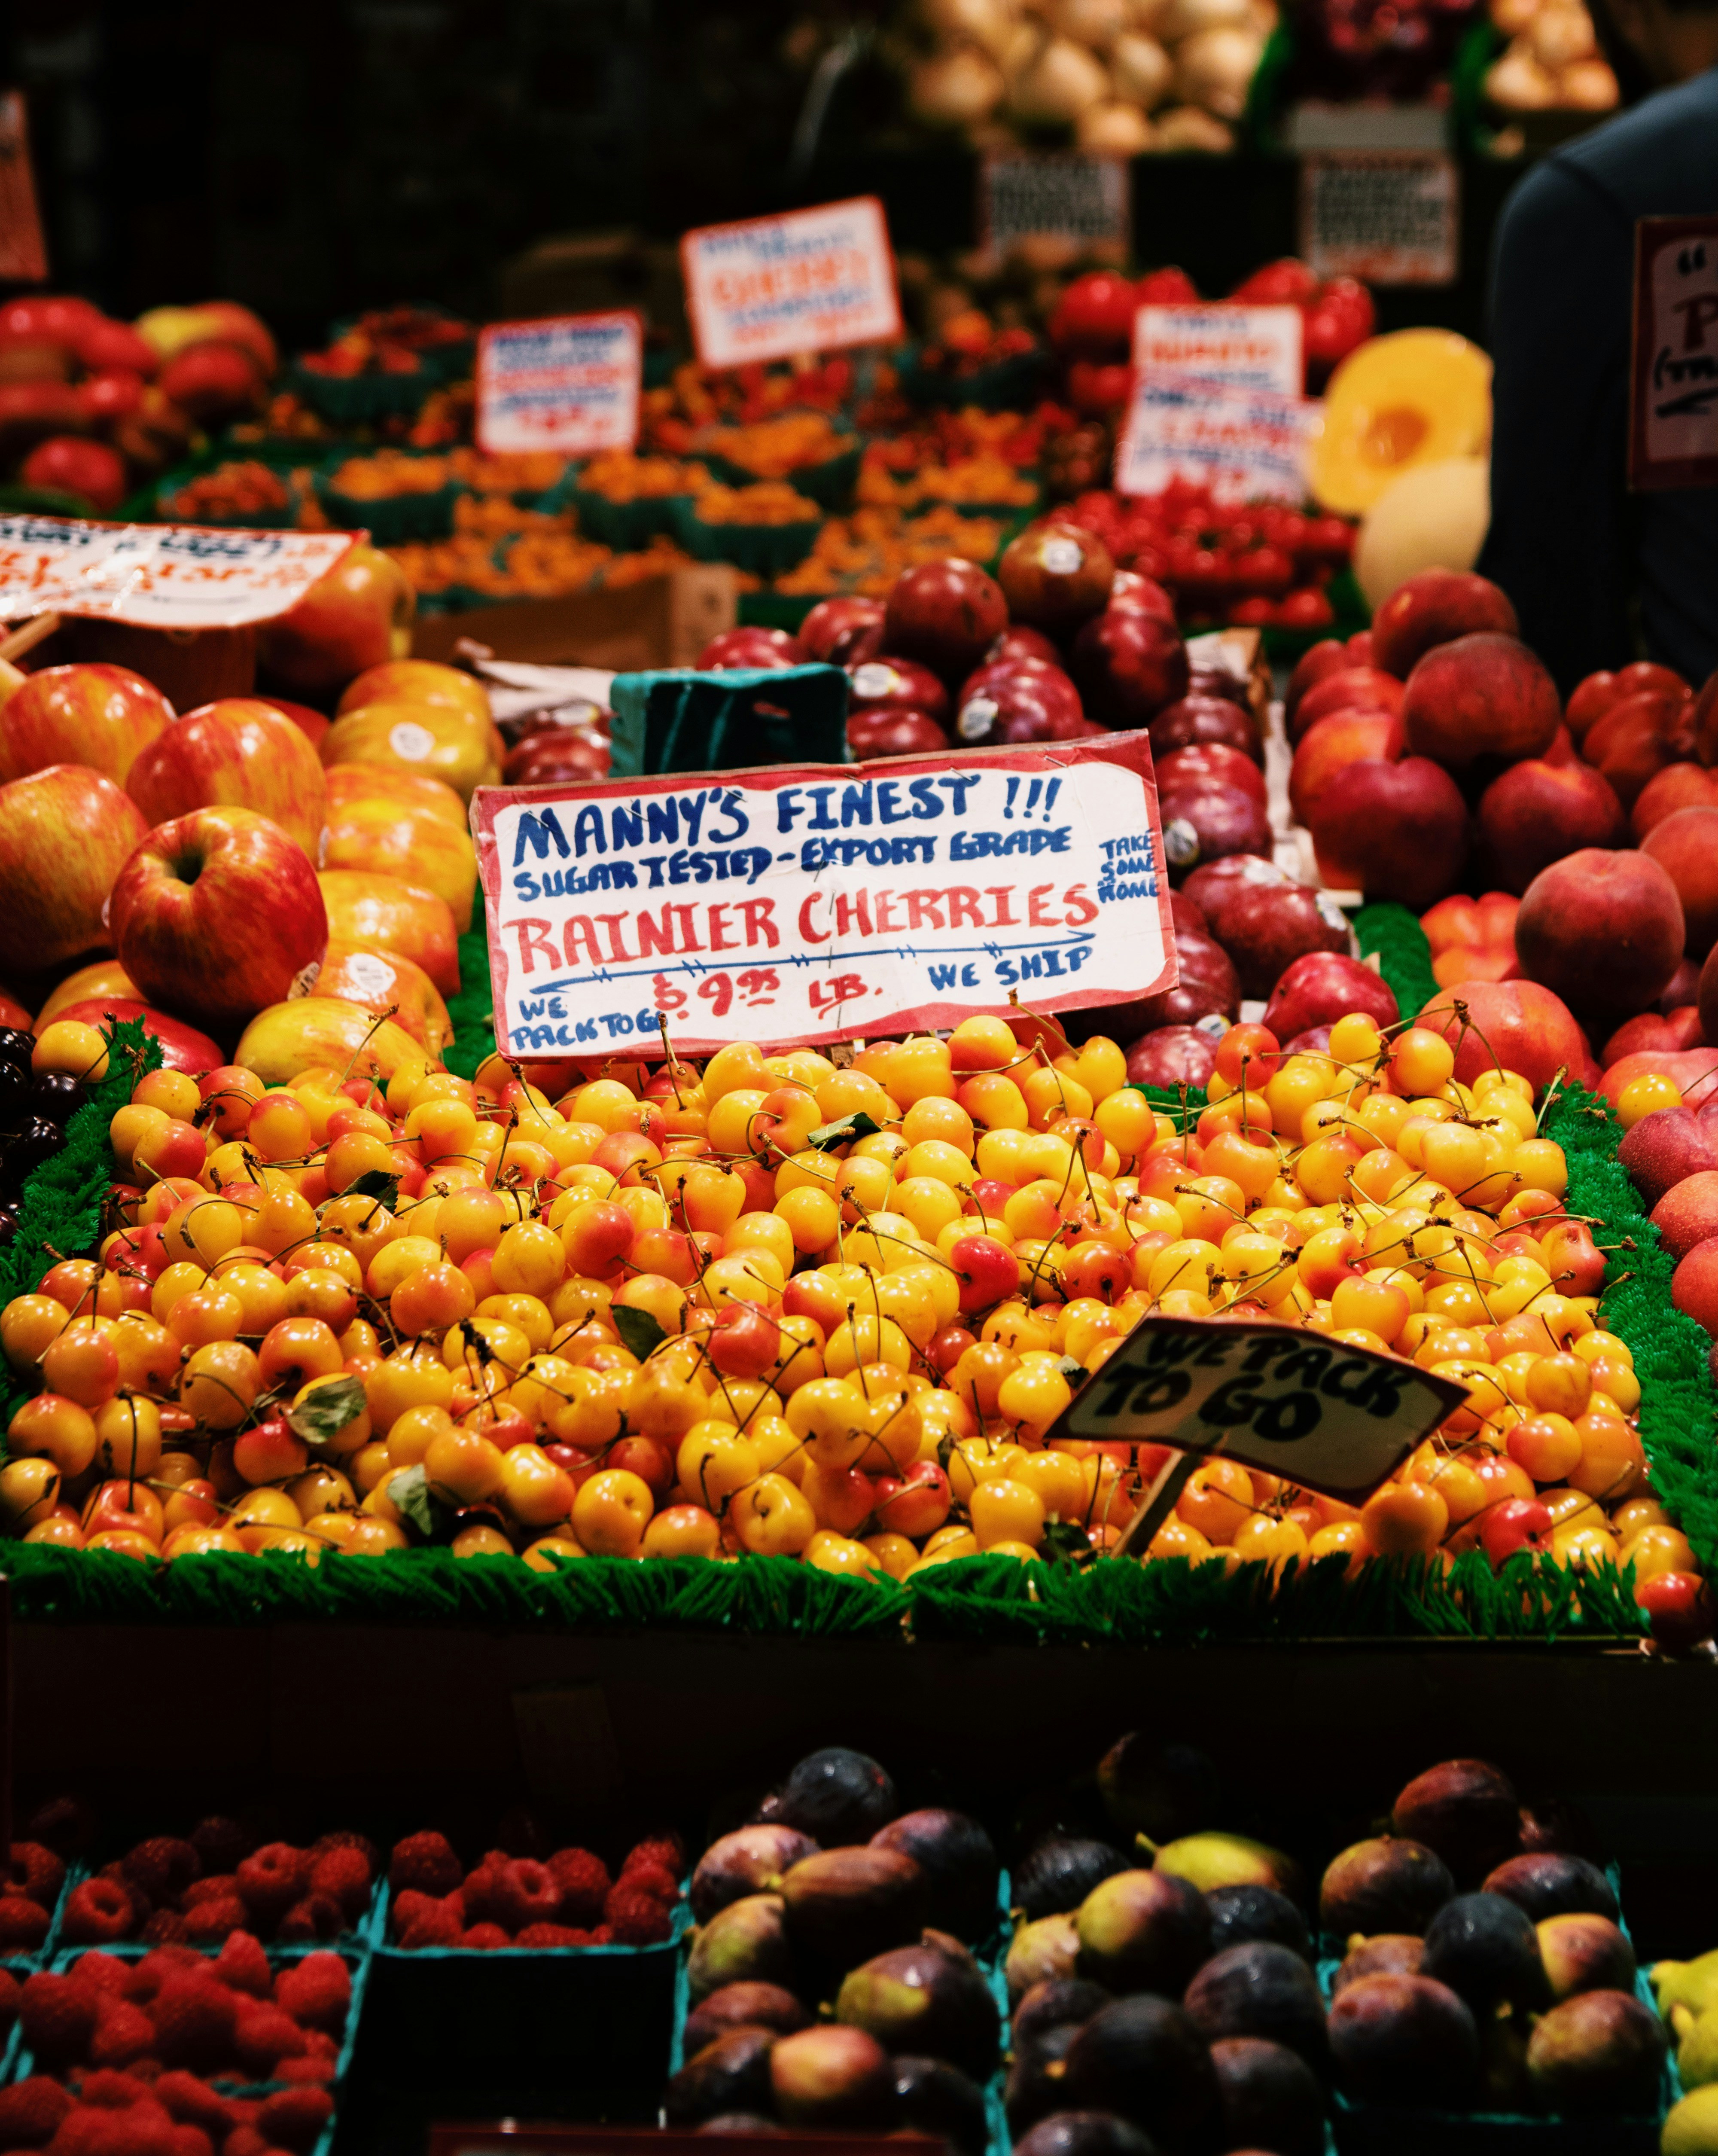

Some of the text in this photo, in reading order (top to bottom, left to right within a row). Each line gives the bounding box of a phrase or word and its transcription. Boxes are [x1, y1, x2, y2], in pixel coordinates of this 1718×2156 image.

[513, 787, 750, 867] MANNY'S
[777, 774, 981, 833] FINEST
[949, 826, 1072, 861] GRADE
[1099, 827, 1156, 860] TAKE
[1101, 852, 1159, 882] SOME
[1097, 877, 1161, 903] HOME
[502, 883, 1100, 974] RAINIER CHERRIES
[927, 945, 1092, 991] WE SHIP
[519, 996, 568, 1021] WE
[509, 1015, 598, 1050] PACK
[599, 1012, 634, 1037] TO
[1146, 1331, 1413, 1417] WE PACK
[1094, 1361, 1322, 1441] TO GO
